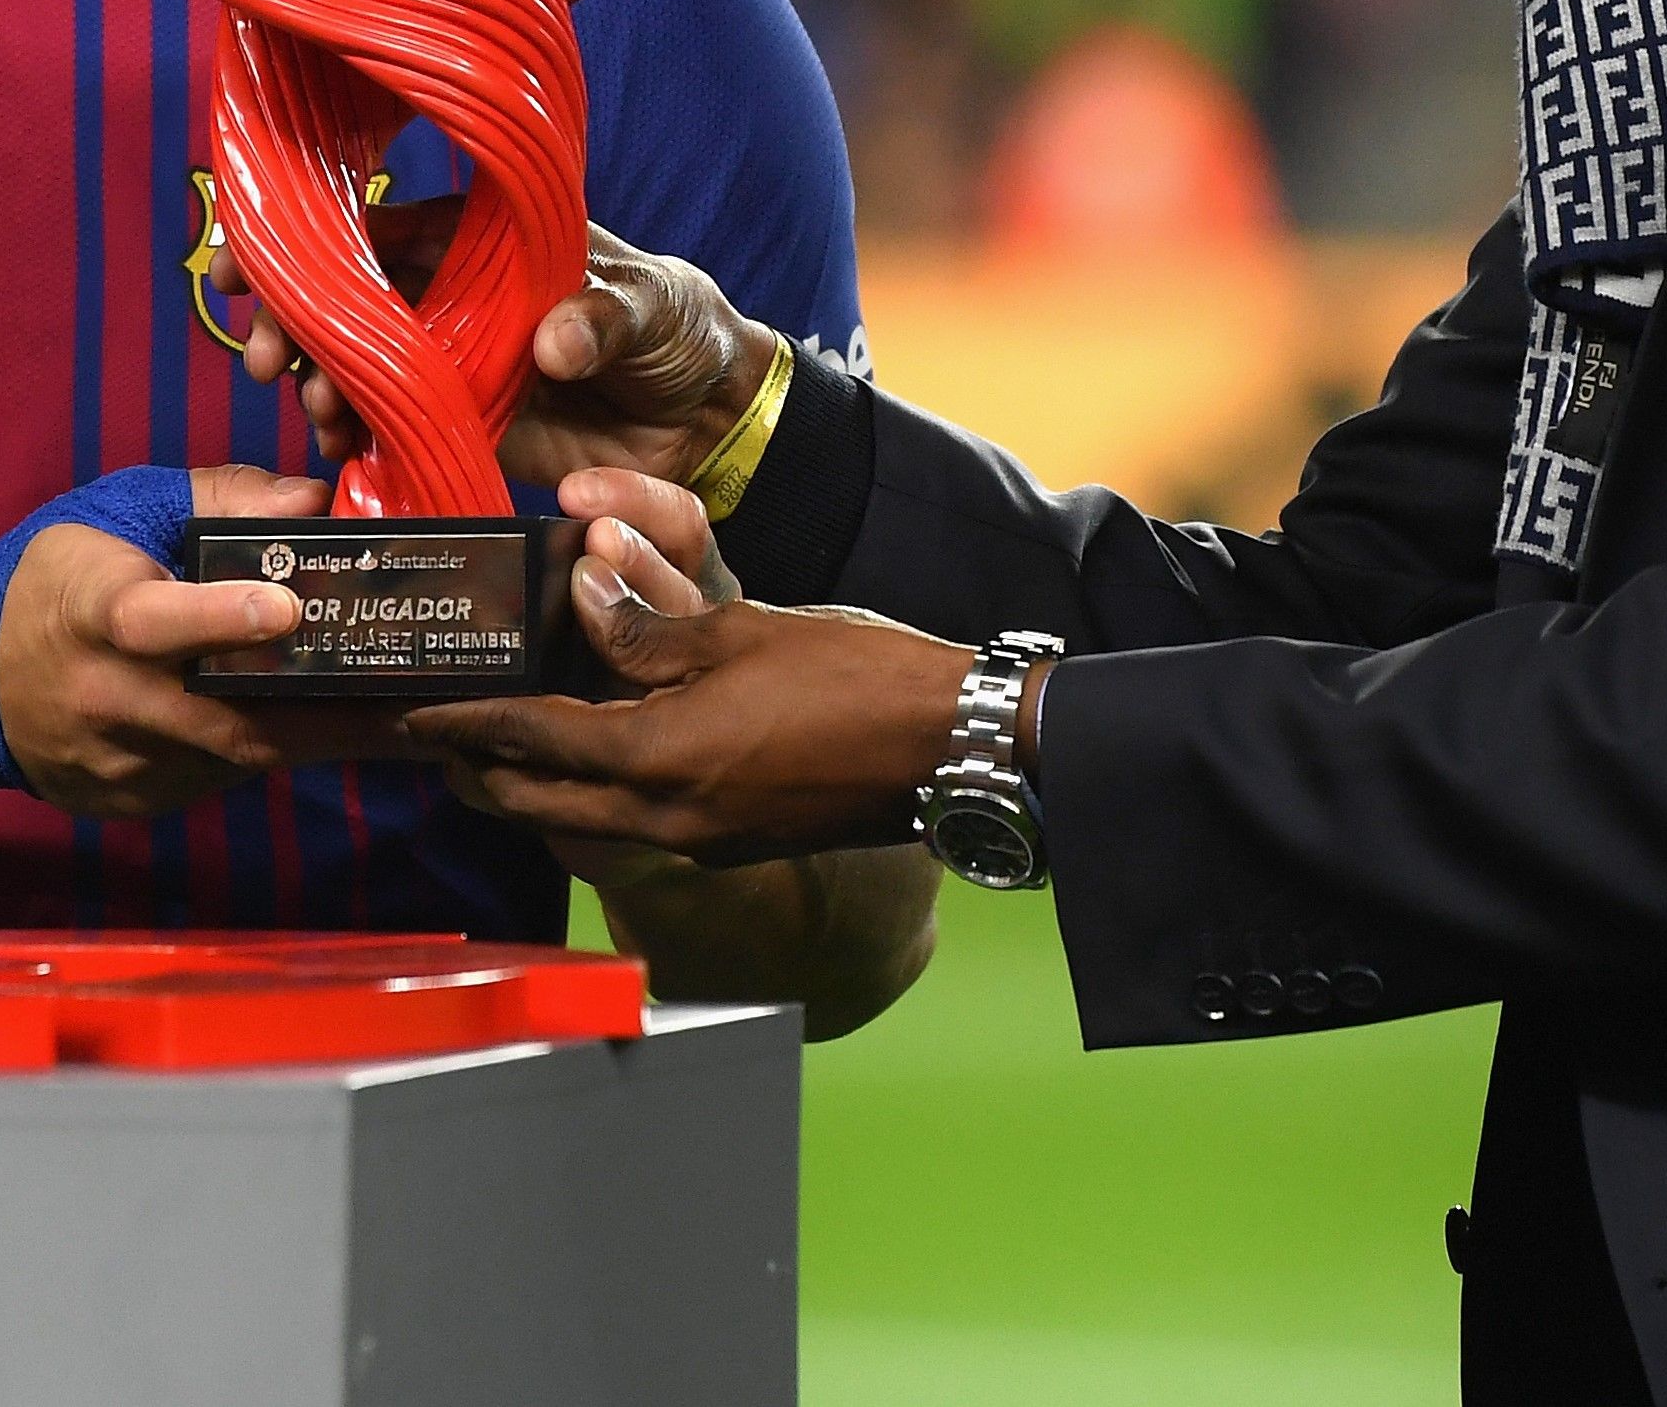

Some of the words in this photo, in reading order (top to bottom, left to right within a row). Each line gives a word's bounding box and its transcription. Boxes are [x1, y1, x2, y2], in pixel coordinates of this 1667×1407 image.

[299, 553, 352, 574] LaLiga
[381, 551, 466, 570] Santander
[346, 597, 472, 626] JUGADOR
[293, 631, 333, 652] LUIS
[338, 627, 413, 652] SUÁREZ
[425, 632, 521, 650] DICIEMBRE
